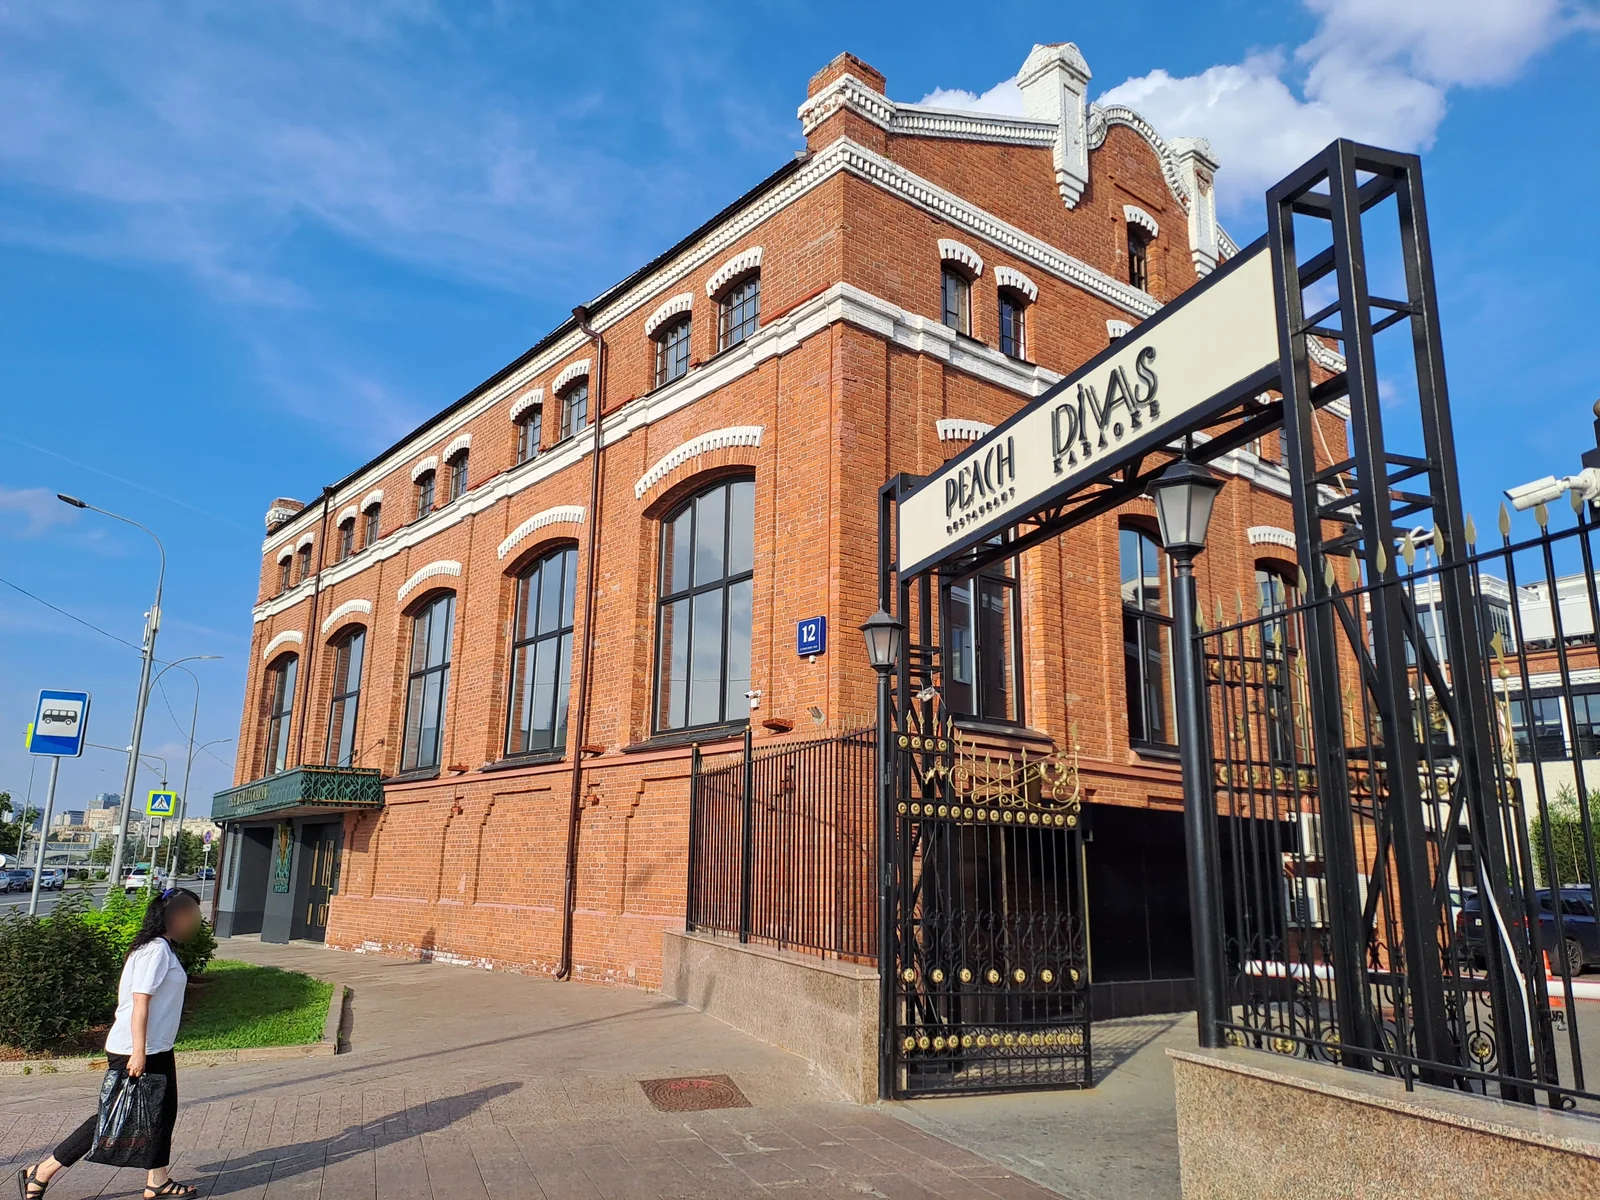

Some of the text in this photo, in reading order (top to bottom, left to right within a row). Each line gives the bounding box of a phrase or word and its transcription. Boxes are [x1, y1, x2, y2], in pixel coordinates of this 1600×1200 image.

[1051, 346, 1158, 457] DIVAS
[1053, 400, 1161, 477] KARAOKE
[946, 436, 1015, 519] PEACH
[946, 487, 1015, 536] RESTAURANT
[802, 624, 816, 643] 12
